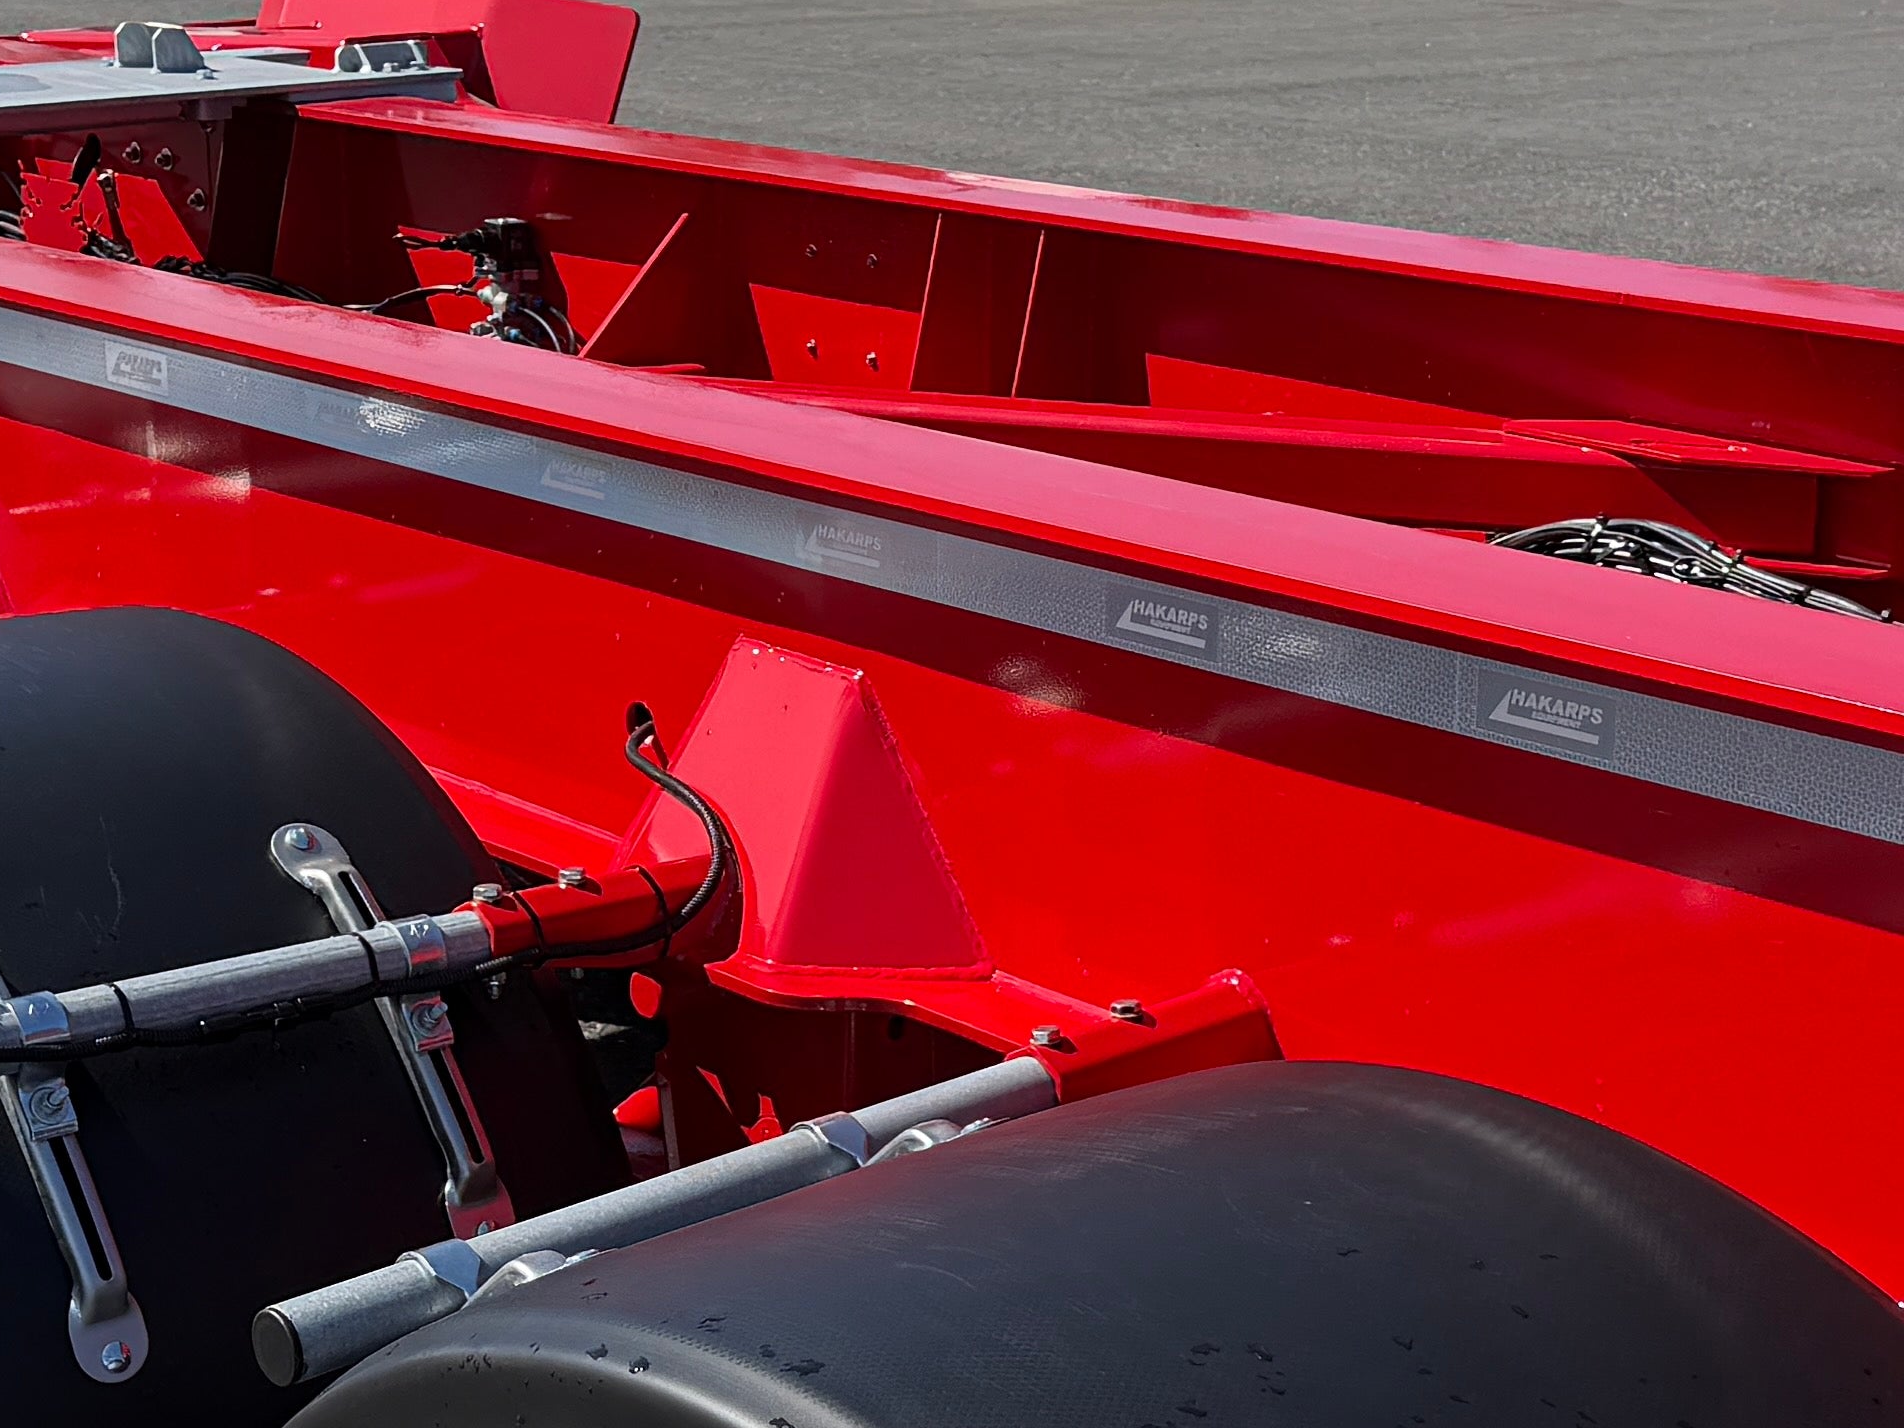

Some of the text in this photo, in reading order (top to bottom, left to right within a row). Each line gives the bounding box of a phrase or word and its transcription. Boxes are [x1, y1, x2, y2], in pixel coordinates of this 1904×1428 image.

[817, 523, 882, 552] HAKARPS
[1132, 598, 1209, 631] HAKARPS
[1510, 688, 1604, 725] HAKARPS
